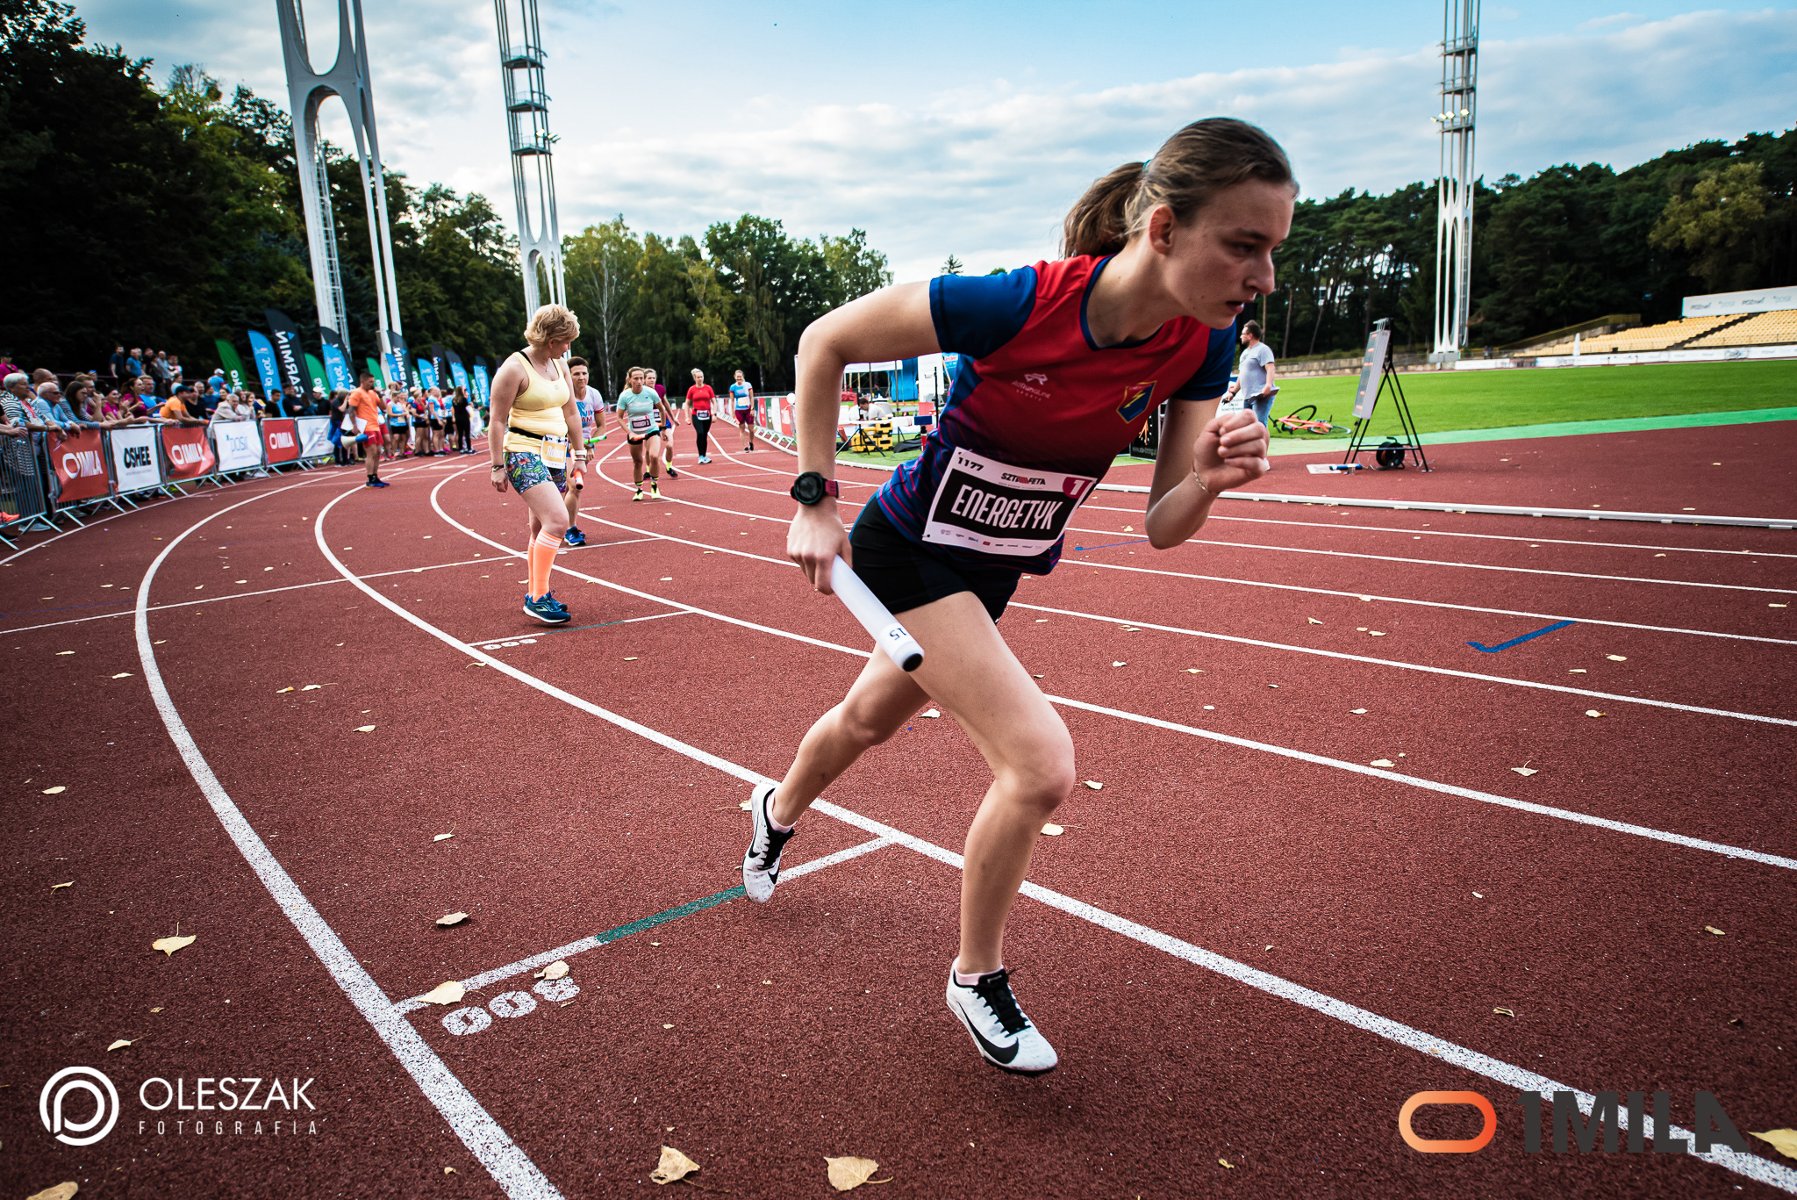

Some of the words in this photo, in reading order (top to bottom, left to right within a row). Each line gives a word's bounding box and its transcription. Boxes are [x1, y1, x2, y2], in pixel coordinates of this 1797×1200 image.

[123, 445, 152, 469] OSHEE
[957, 457, 984, 472] 1177
[1070, 480, 1084, 496] 1
[950, 484, 1063, 530] ENERGETYK
